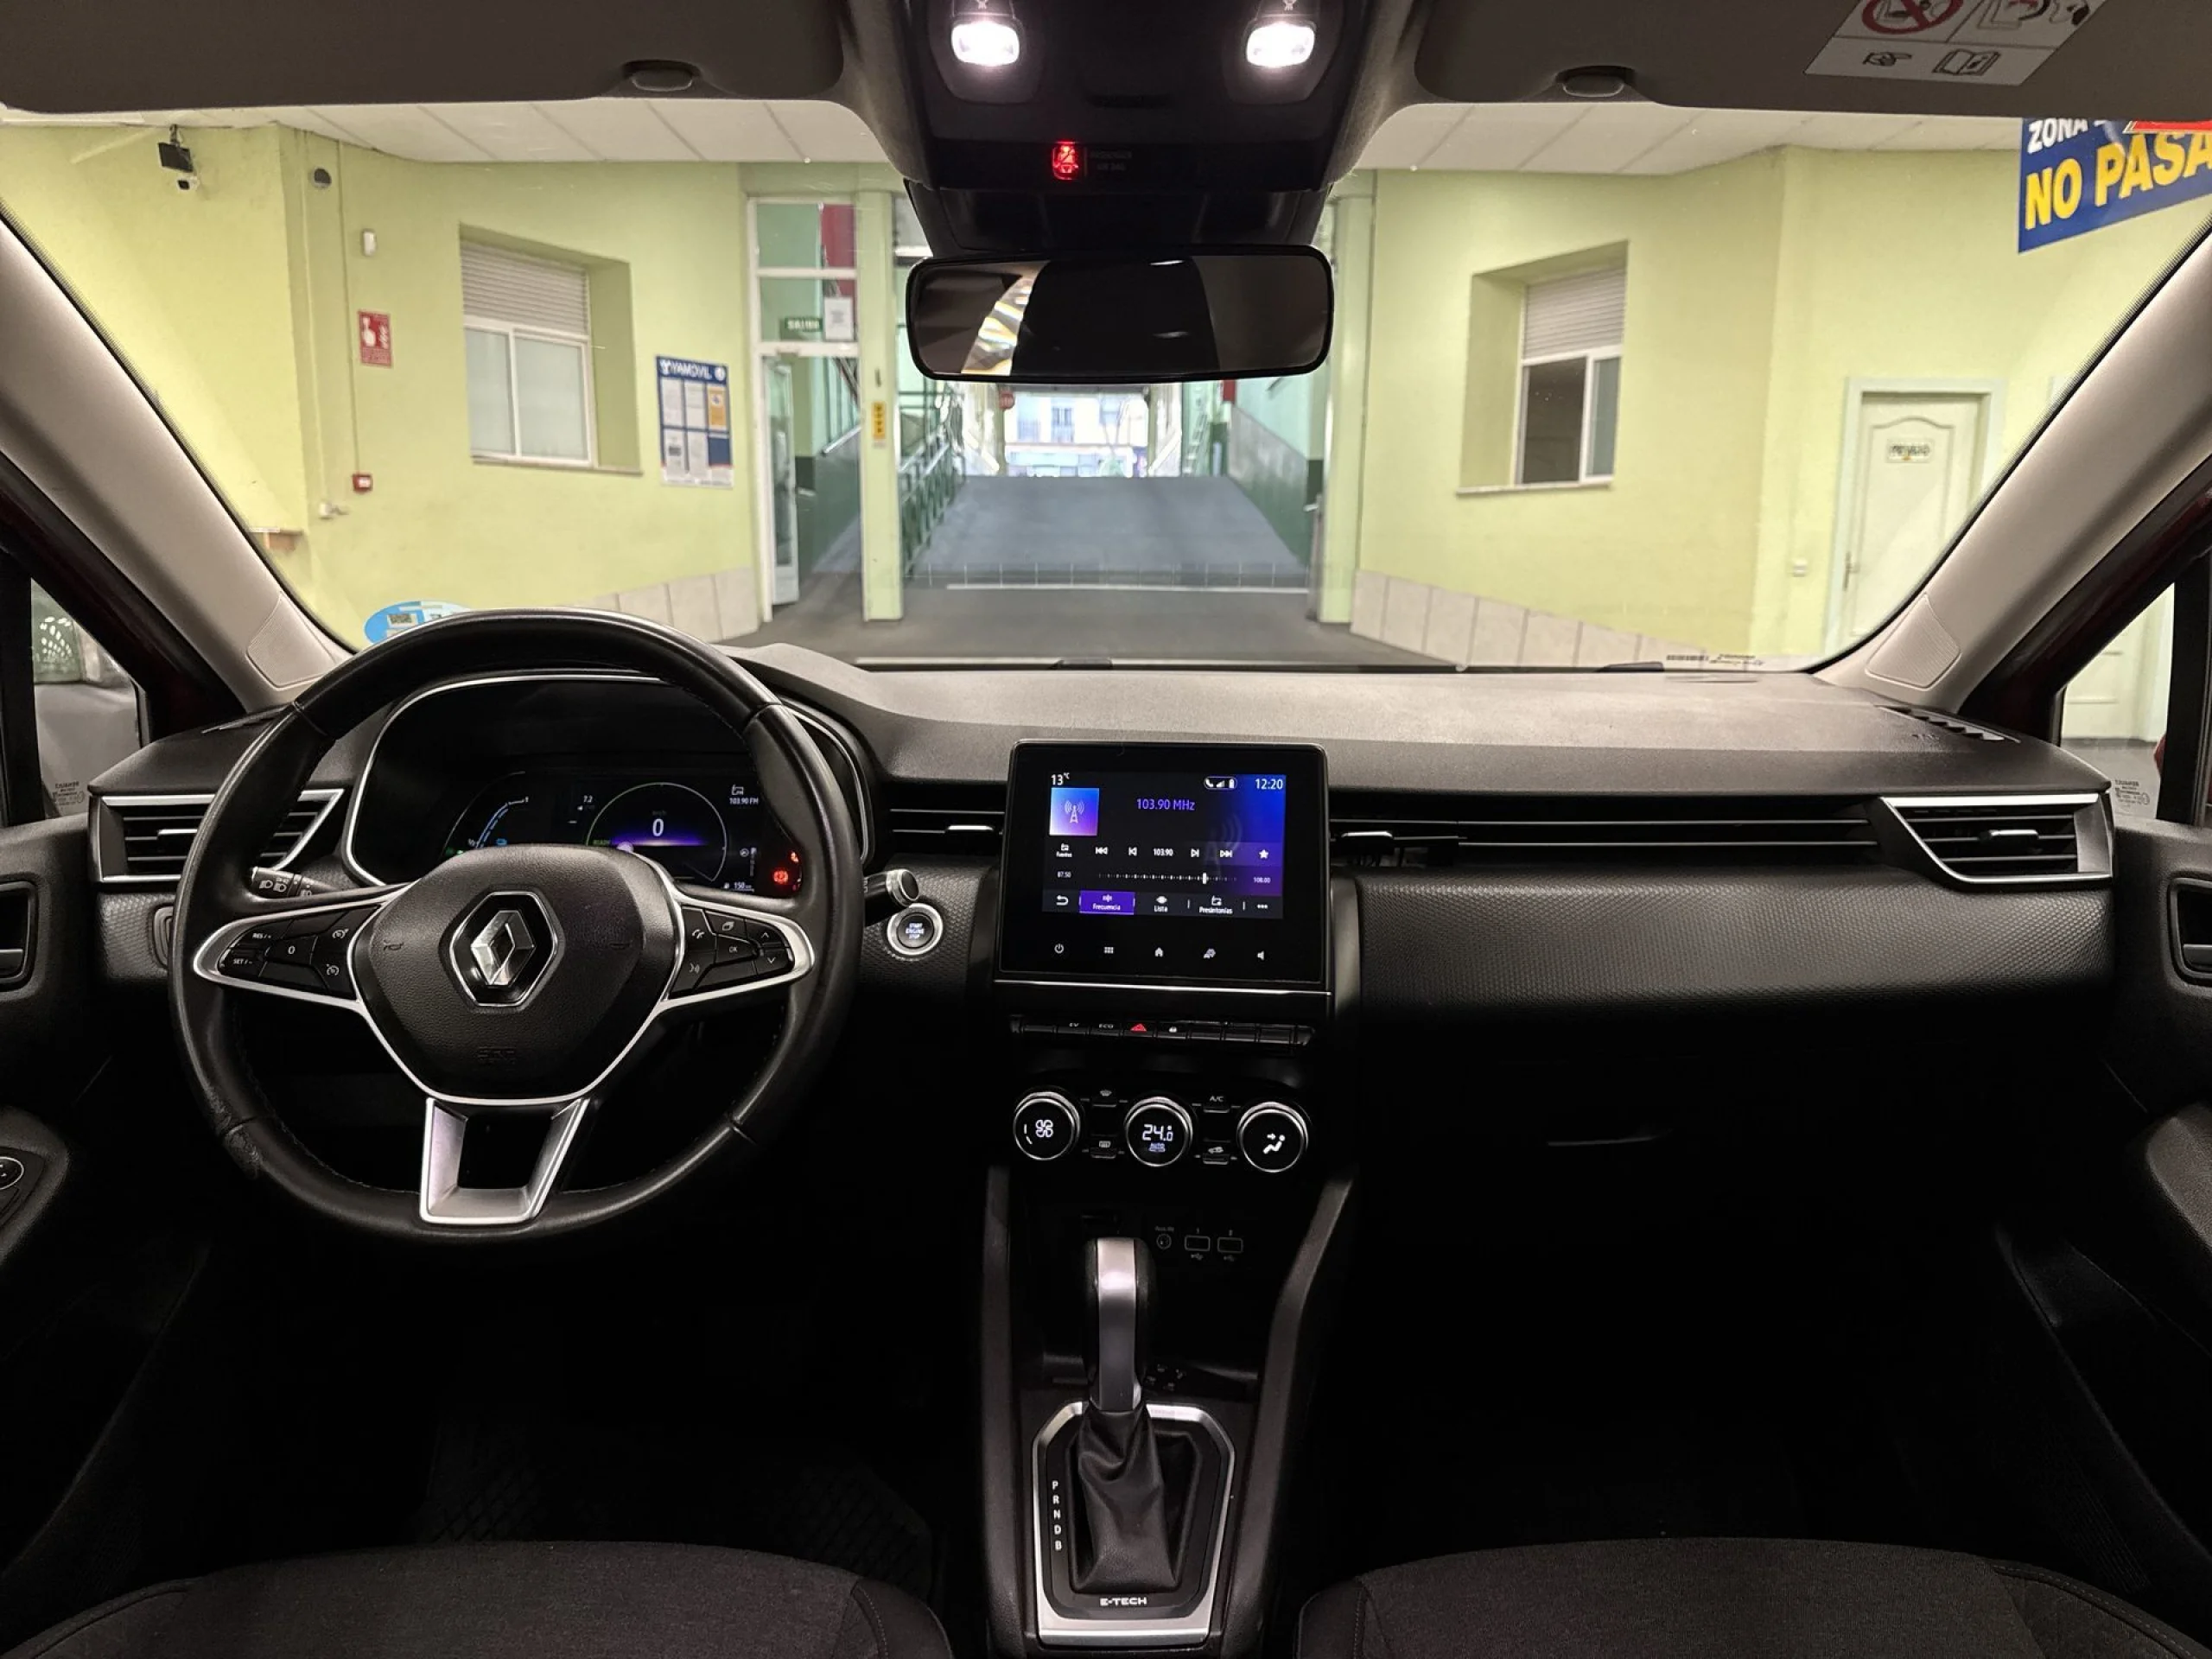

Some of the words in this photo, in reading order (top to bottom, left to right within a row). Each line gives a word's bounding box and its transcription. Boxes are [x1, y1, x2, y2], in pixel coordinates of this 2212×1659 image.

[2027, 118, 2088, 153] ZONA
[2024, 158, 2082, 230] NO
[2095, 132, 2212, 207] PASA
[1255, 778, 1283, 790] 12:20
[1136, 798, 1171, 810] 103.90
[1173, 799, 1196, 811] MHz
[652, 818, 664, 837] 0
[1153, 848, 1173, 857] 103.90
[1092, 902, 1121, 912] Frecuencia
[1052, 1480, 1058, 1490] P
[1052, 1495, 1059, 1504] R
[1053, 1510, 1061, 1519] N
[1053, 1524, 1061, 1535] D
[1054, 1541, 1062, 1551] B
[1099, 1597, 1147, 1607] E-TECH
